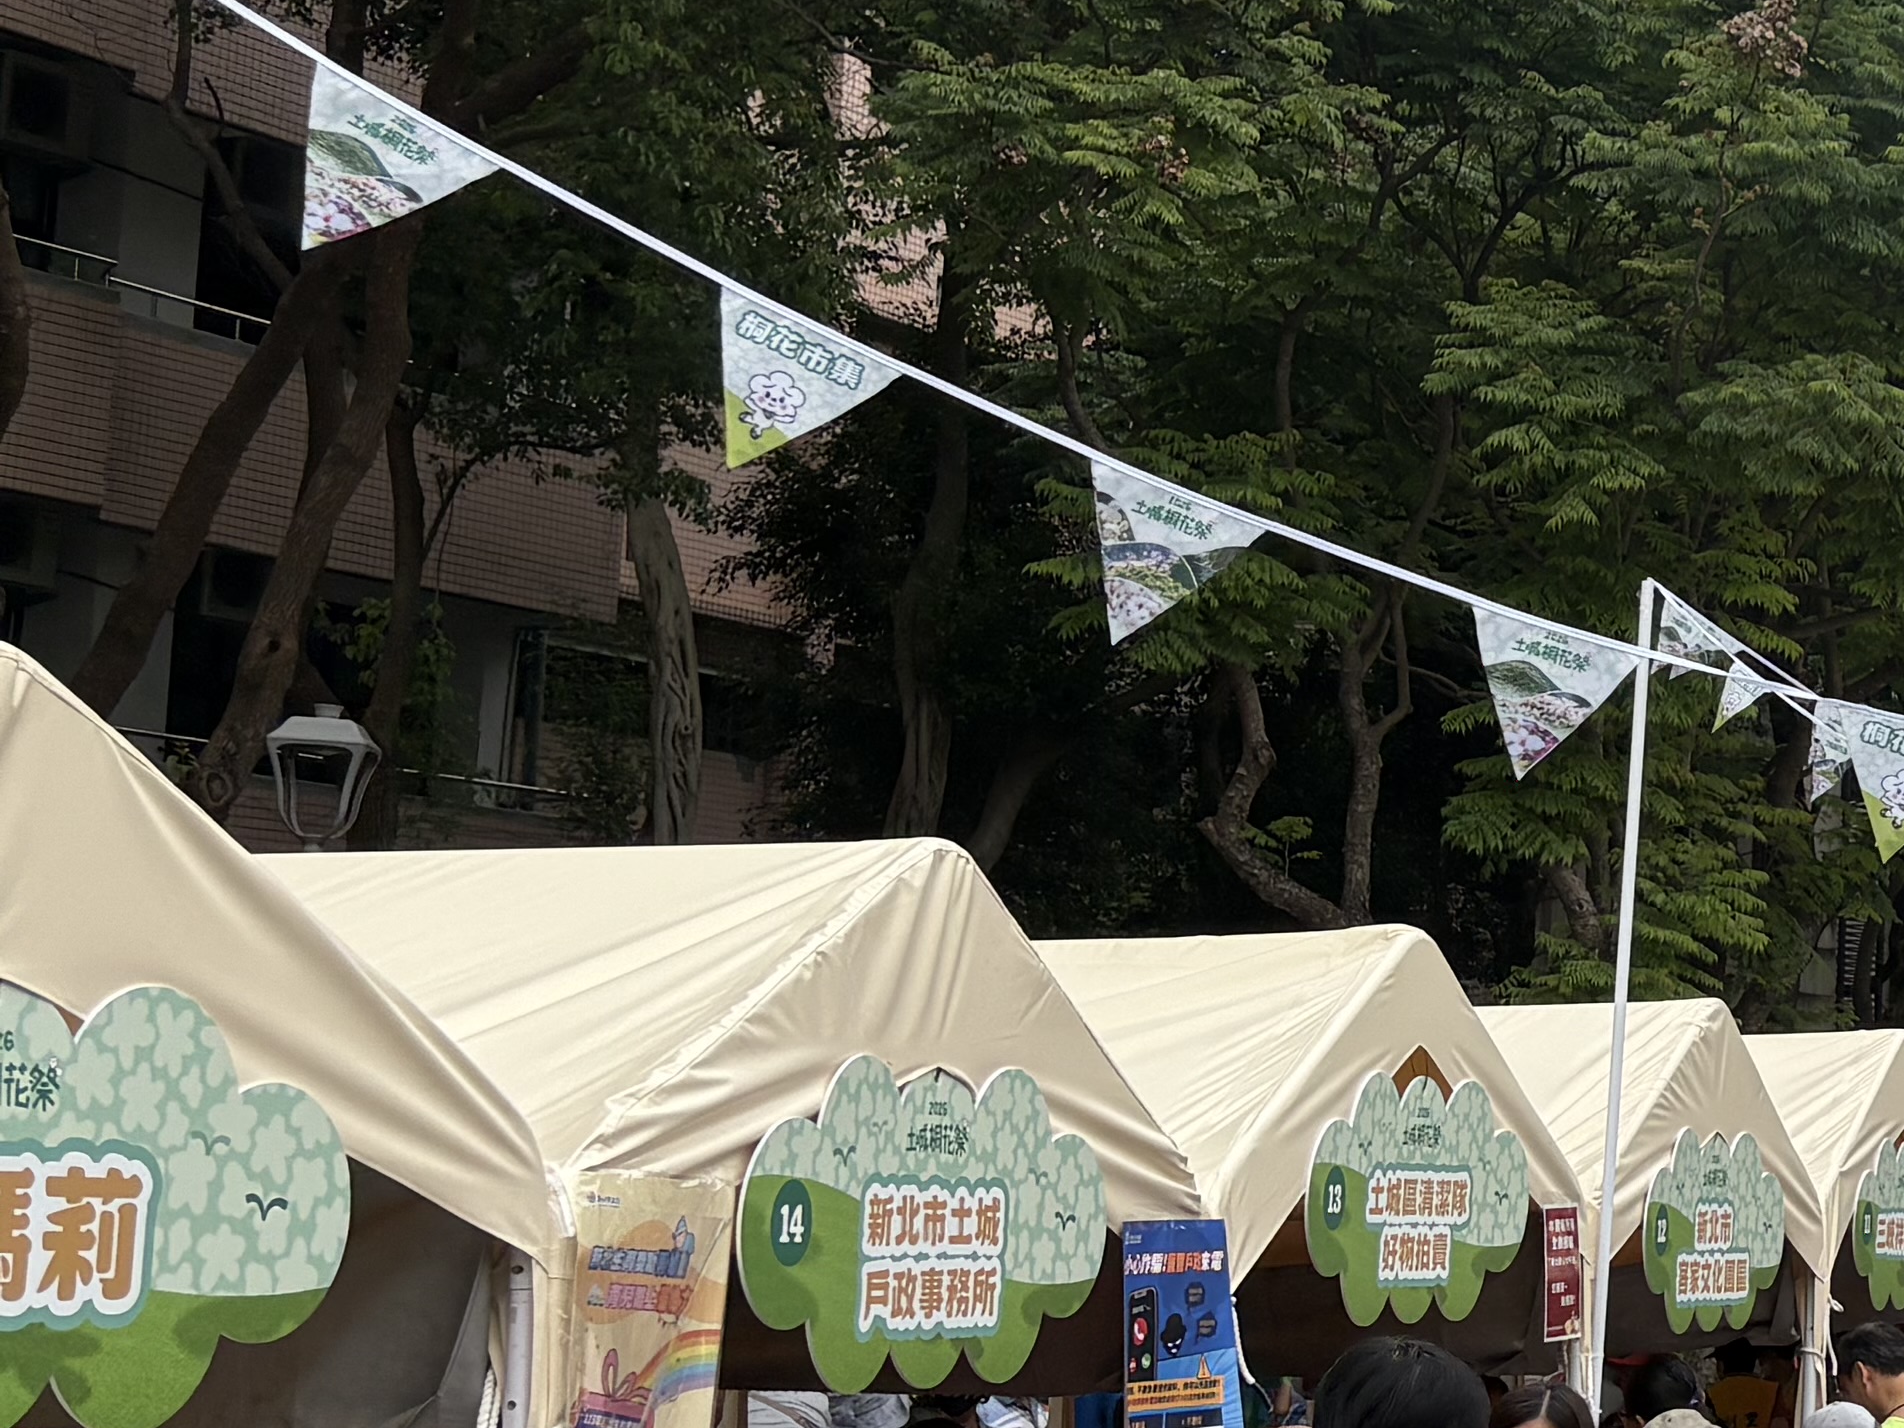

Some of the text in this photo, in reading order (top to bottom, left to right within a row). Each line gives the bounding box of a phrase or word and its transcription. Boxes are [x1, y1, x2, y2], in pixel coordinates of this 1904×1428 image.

[736, 311, 865, 390] 桐花市集
[0, 1062, 60, 1112] 花祭
[906, 1123, 969, 1158] 土城桐花祭
[1328, 1184, 1342, 1215] 13
[1369, 1178, 1468, 1218] 土城區清潔隊
[779, 1203, 805, 1244] 14
[867, 1193, 1001, 1247] 新北市土城
[1657, 1219, 1667, 1243] 12
[1697, 1210, 1732, 1245] 新北市
[1382, 1232, 1448, 1272] 好物拍賣
[863, 1267, 998, 1322] 戶政事務所
[1678, 1259, 1748, 1295] 客家文化園區
